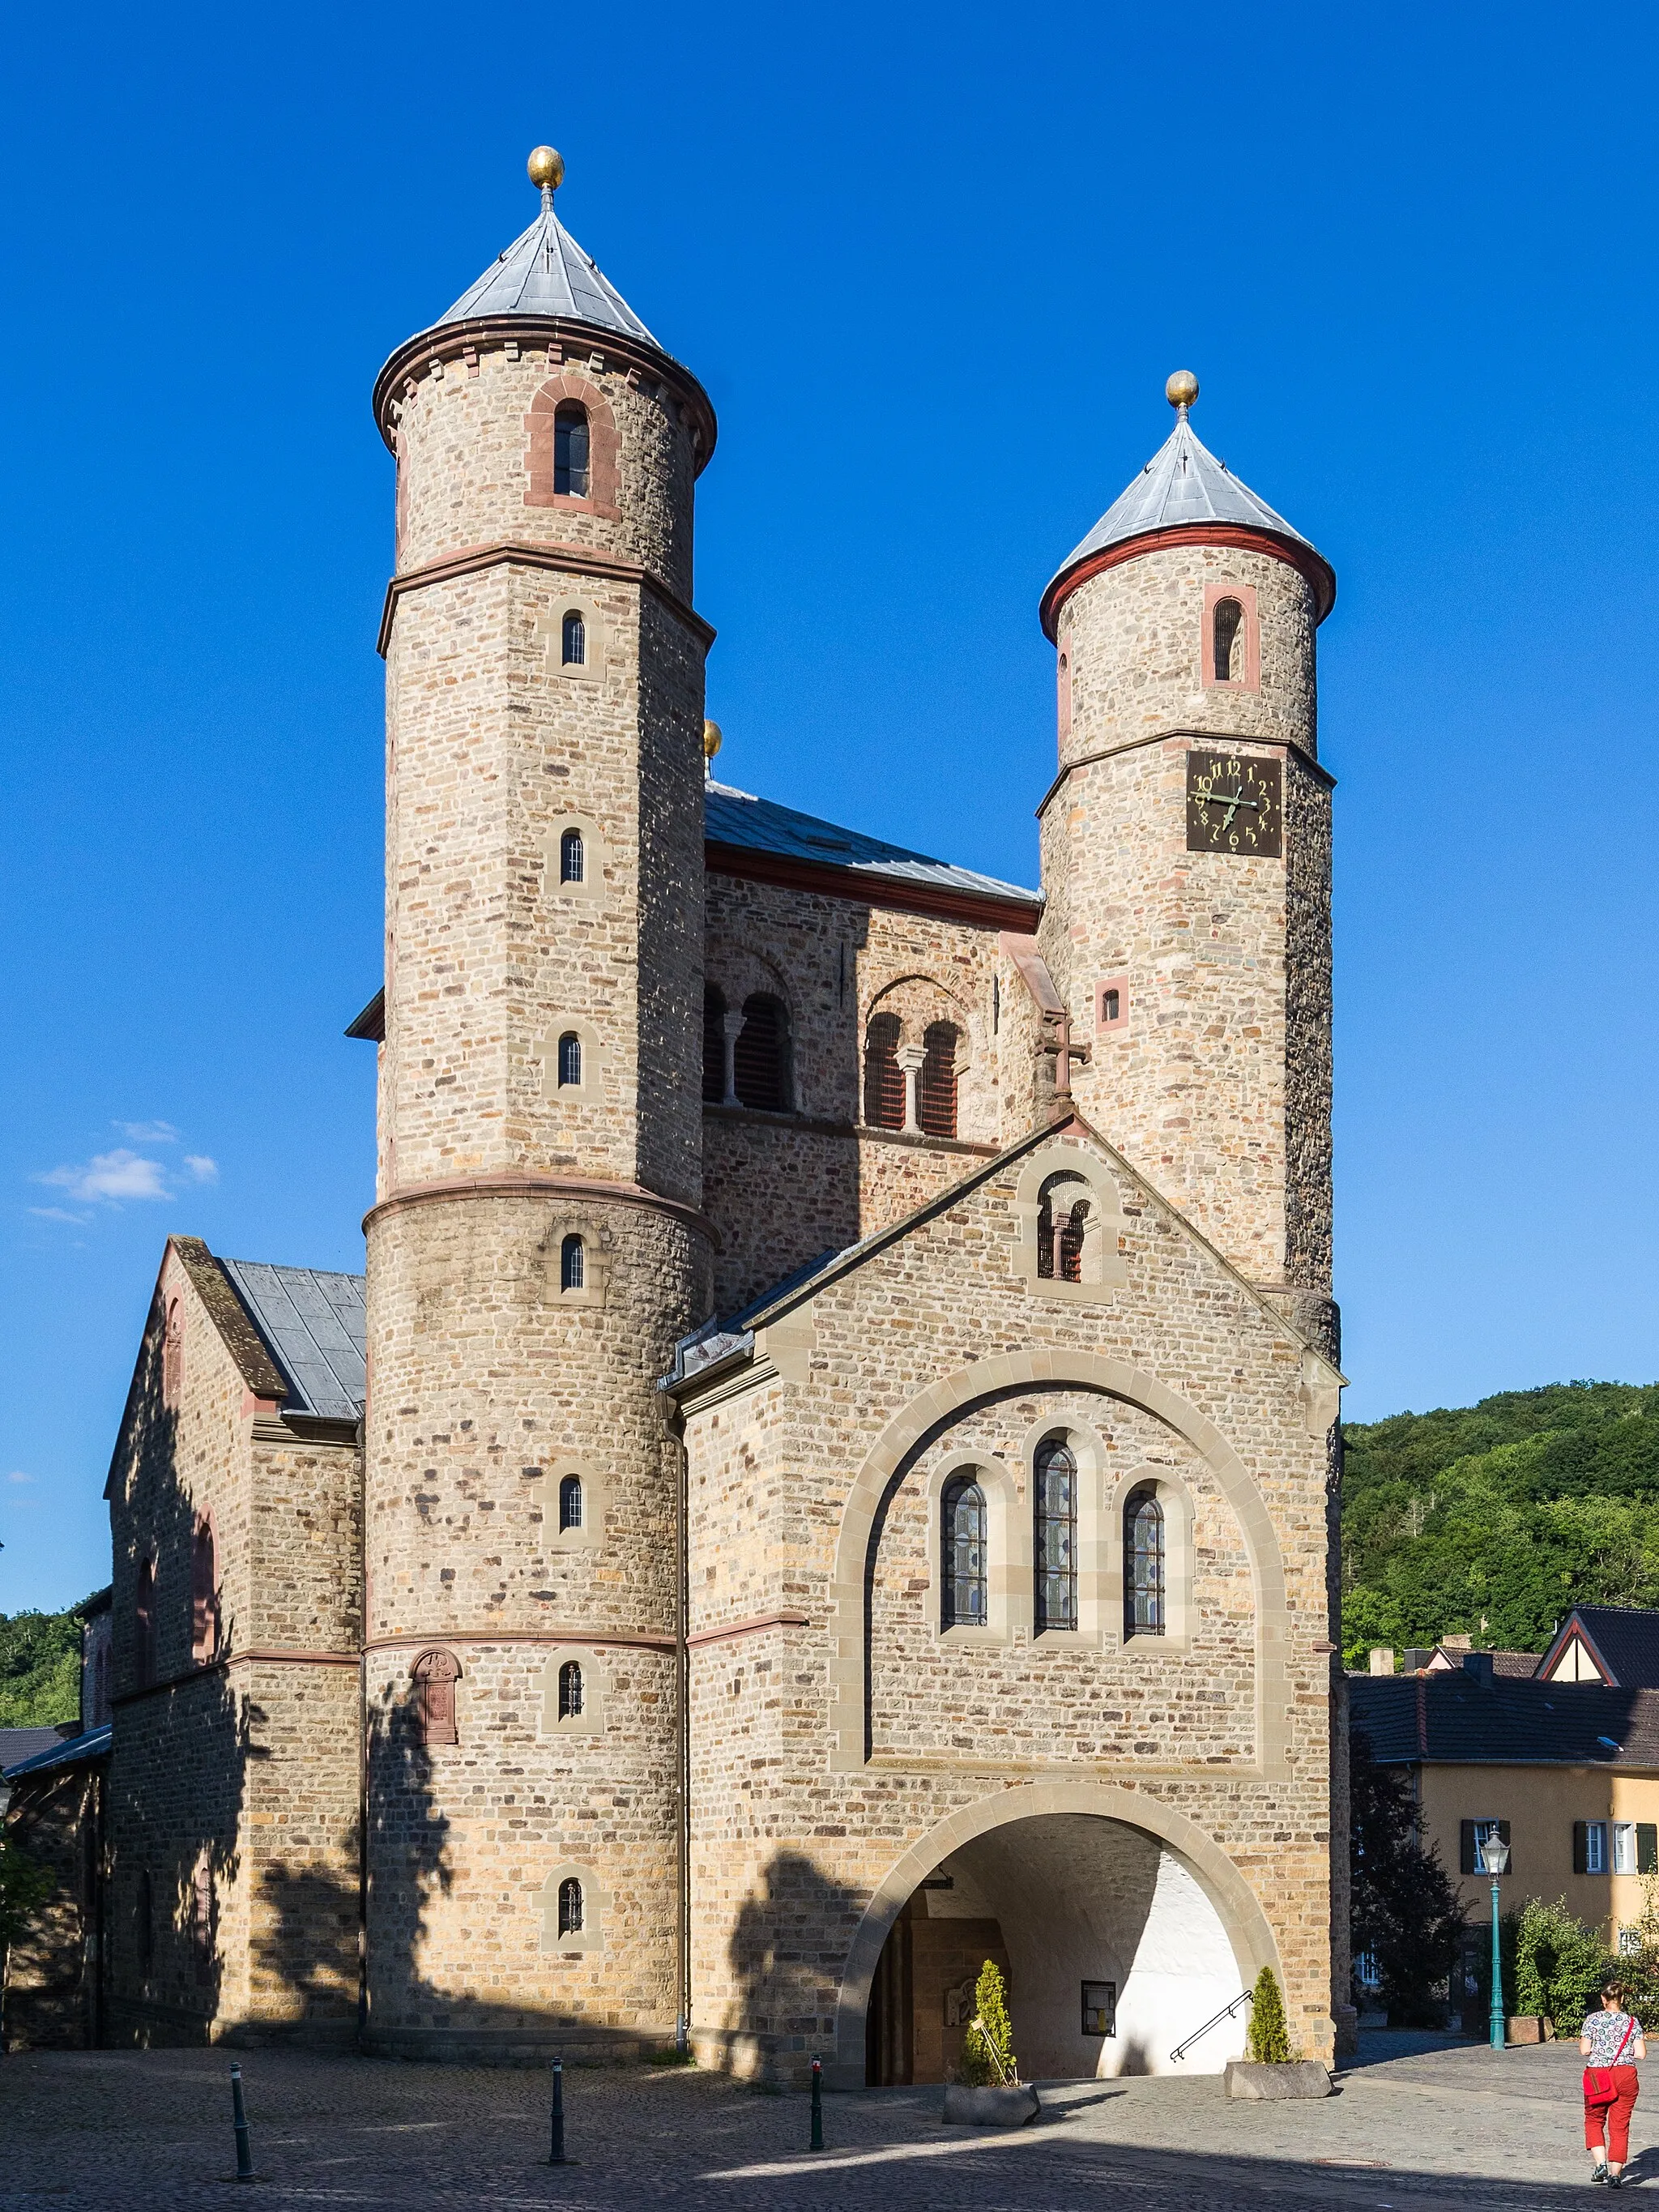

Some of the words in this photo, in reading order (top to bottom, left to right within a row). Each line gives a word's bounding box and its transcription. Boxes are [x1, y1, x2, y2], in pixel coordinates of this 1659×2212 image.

[1210, 762, 1223, 780] 11
[1226, 760, 1241, 776] 12
[1247, 767, 1255, 783] 1
[1196, 775, 1213, 792] 10
[1259, 780, 1266, 796] 2
[1195, 794, 1205, 809] 9
[1262, 797, 1271, 815] 3
[1201, 811, 1209, 826] 8
[1259, 815, 1268, 831] 4
[1212, 824, 1221, 840] 7
[1230, 831, 1239, 846] 6
[1246, 827, 1256, 844] 5
